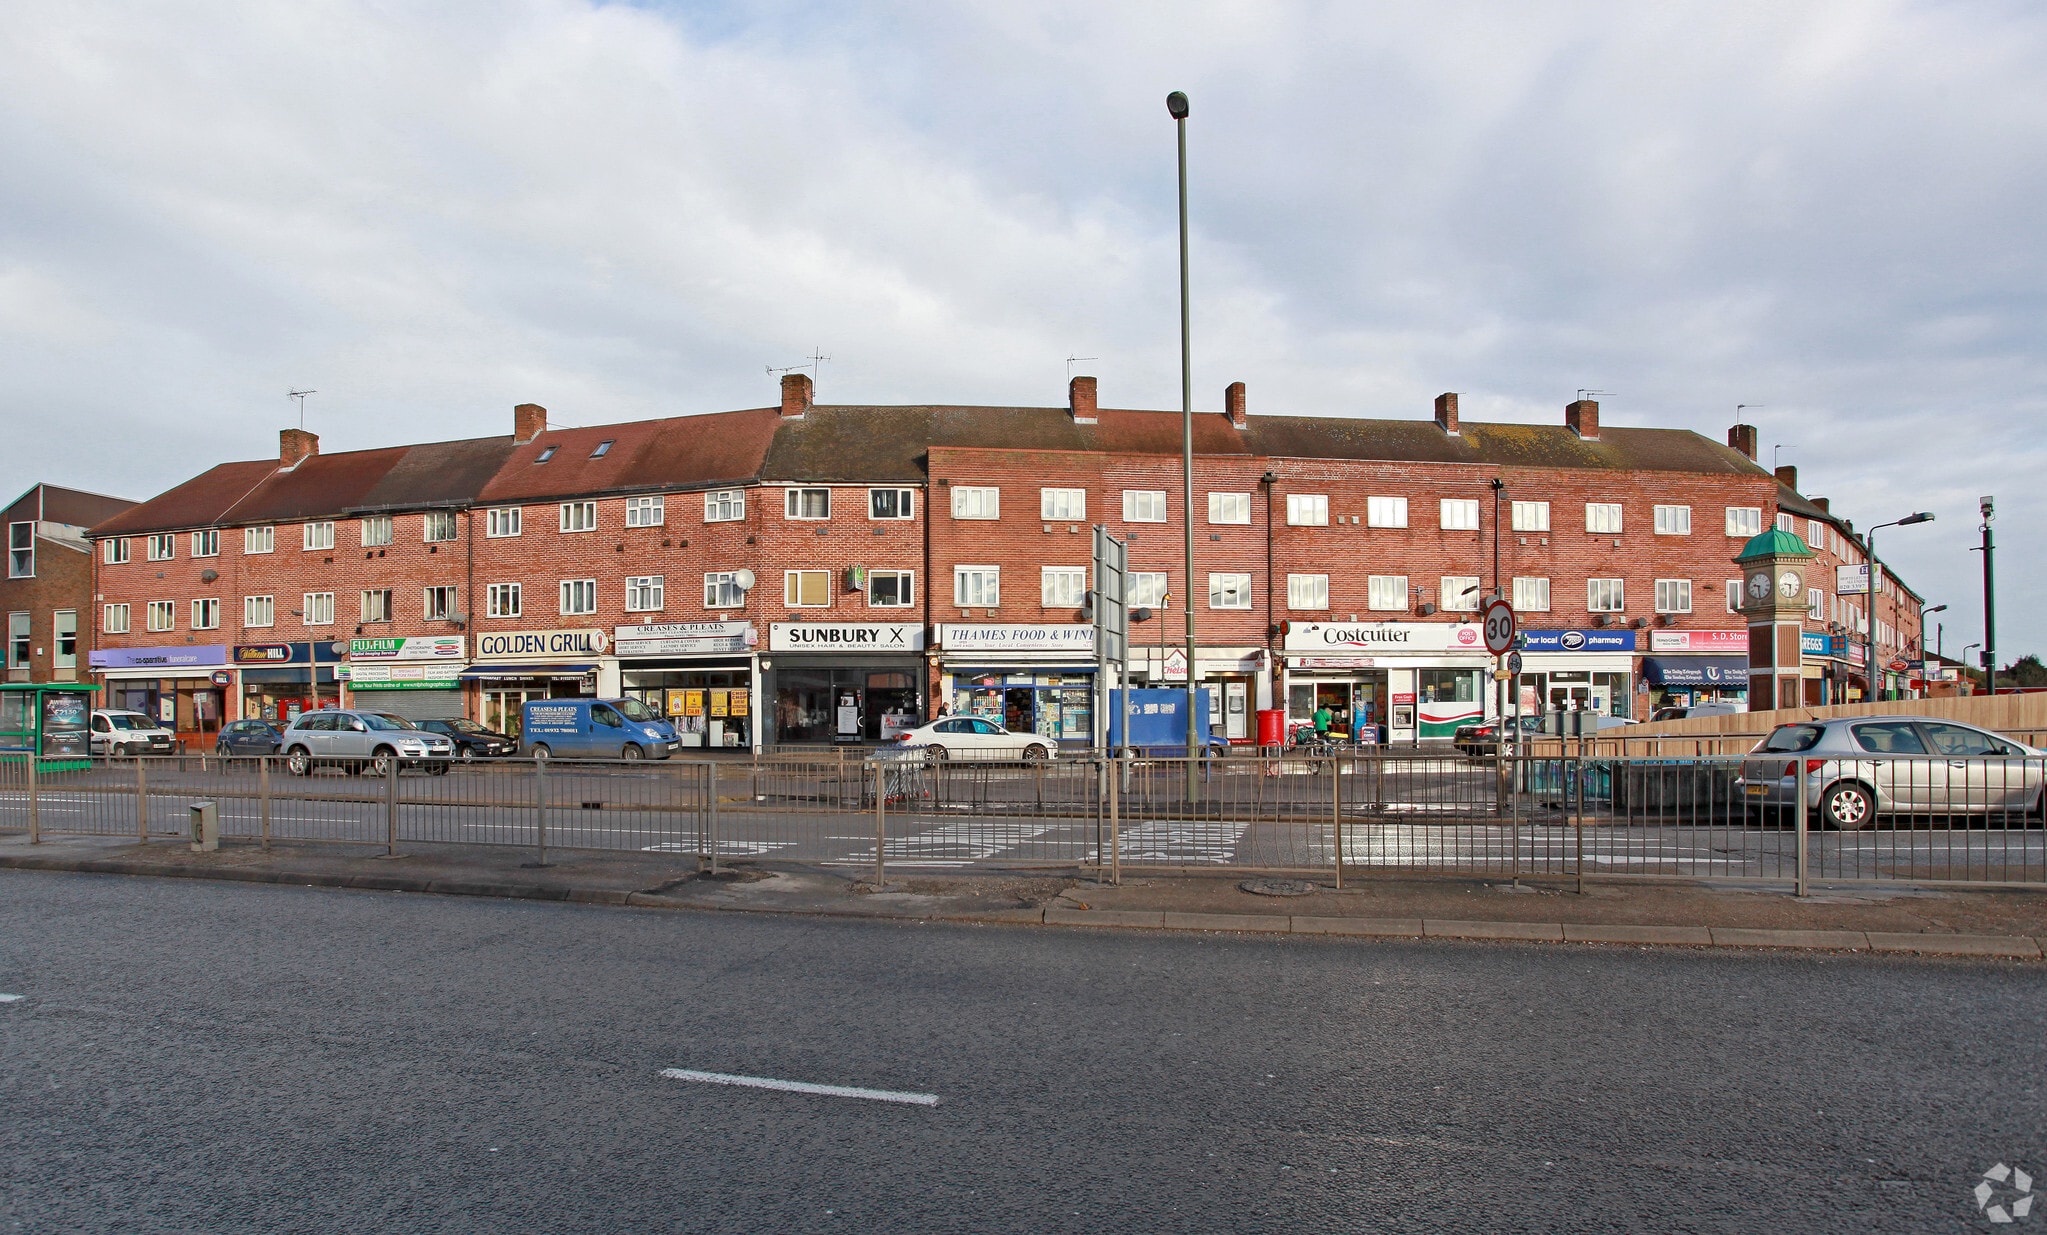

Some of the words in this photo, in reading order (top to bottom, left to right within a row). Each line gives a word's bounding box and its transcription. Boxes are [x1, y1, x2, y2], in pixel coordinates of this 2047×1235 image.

[952, 629, 1006, 640] THAMES
[1012, 630, 1046, 640] FOOD
[1050, 630, 1058, 640] &
[1487, 617, 1511, 640] 30
[790, 628, 880, 642] SUNBURY
[890, 628, 904, 643] X
[1324, 627, 1410, 644] Costcutter
[1588, 636, 1623, 644] pharmacy
[1712, 632, 1719, 640] S.
[1720, 632, 1728, 640] D.
[482, 634, 545, 654] GOLDEN
[550, 634, 592, 652] GRILL
[267, 648, 284, 659] HILL
